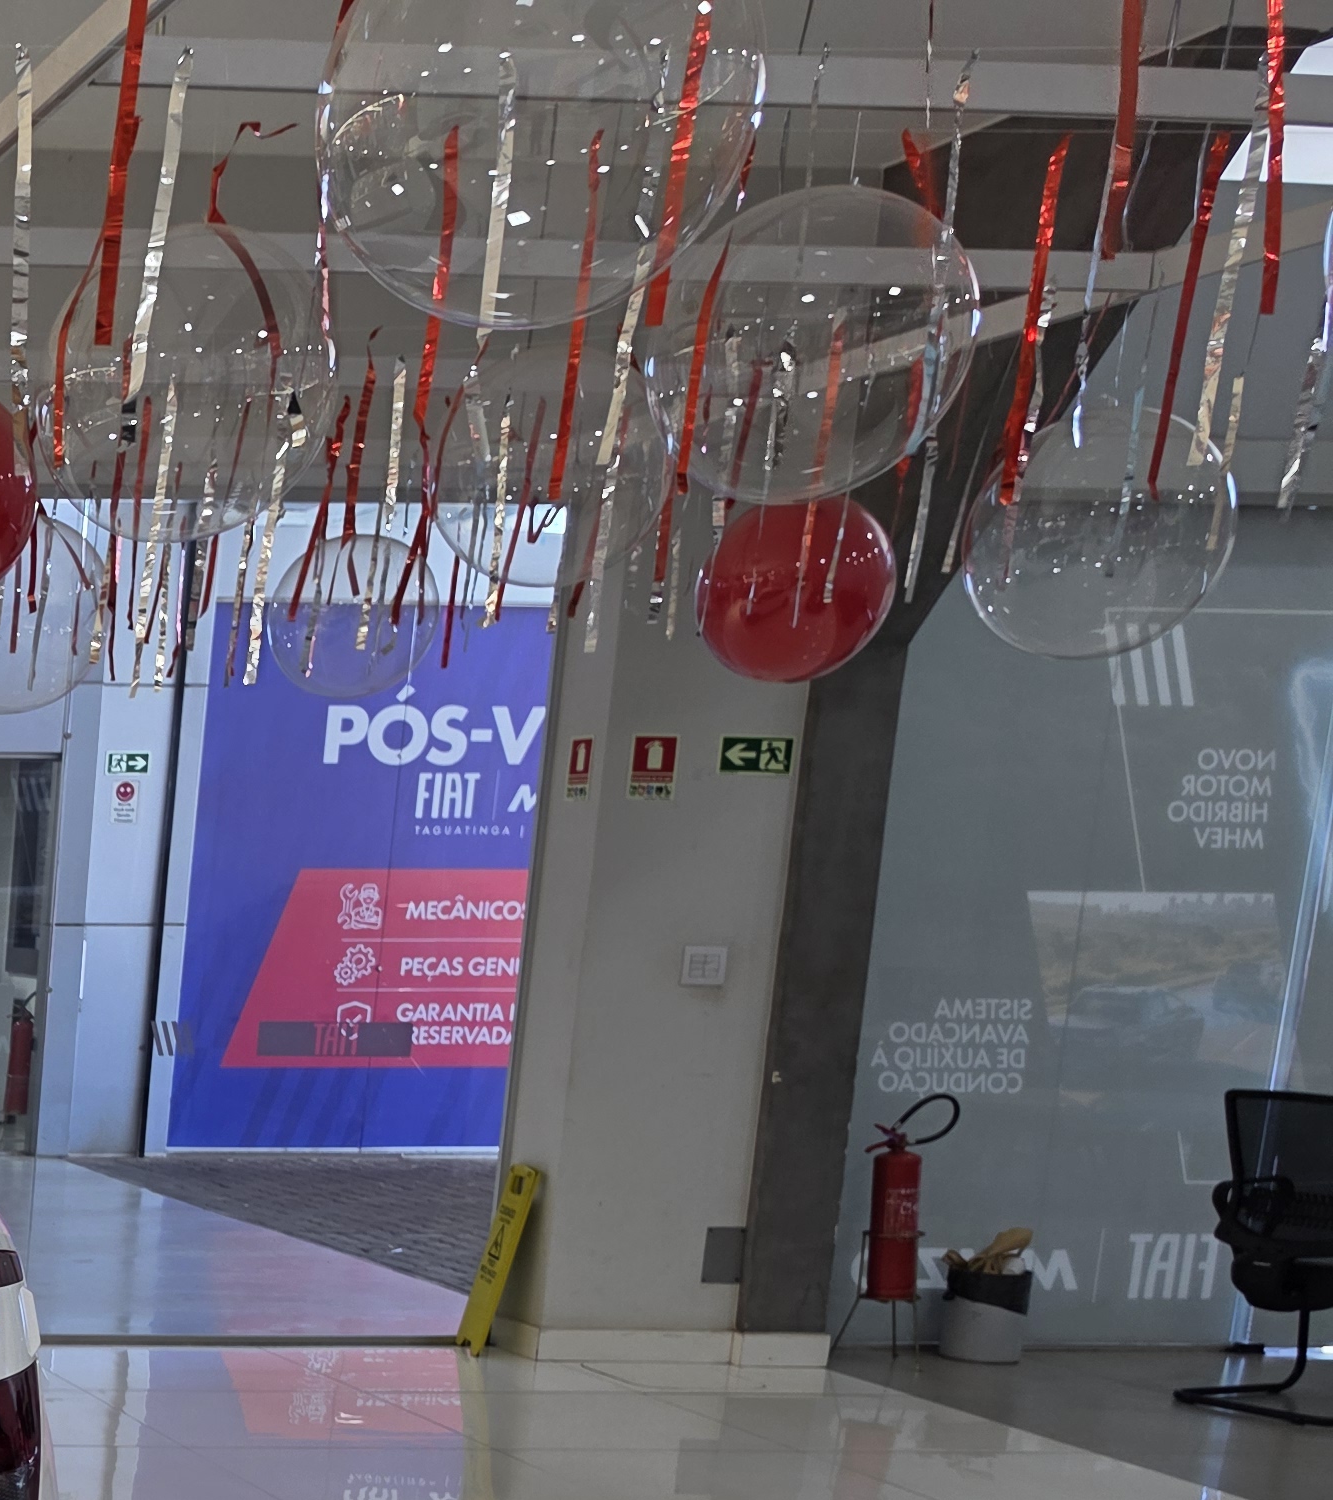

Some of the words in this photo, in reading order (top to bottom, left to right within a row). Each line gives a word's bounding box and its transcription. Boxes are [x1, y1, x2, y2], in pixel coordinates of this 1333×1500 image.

[415, 772, 481, 819] FIAT
[415, 825, 510, 836] TAGUATINGA
[400, 957, 463, 982] PEÇAS
[396, 1003, 504, 1022] GARANTIA
[411, 1026, 512, 1045] RESERVAD
